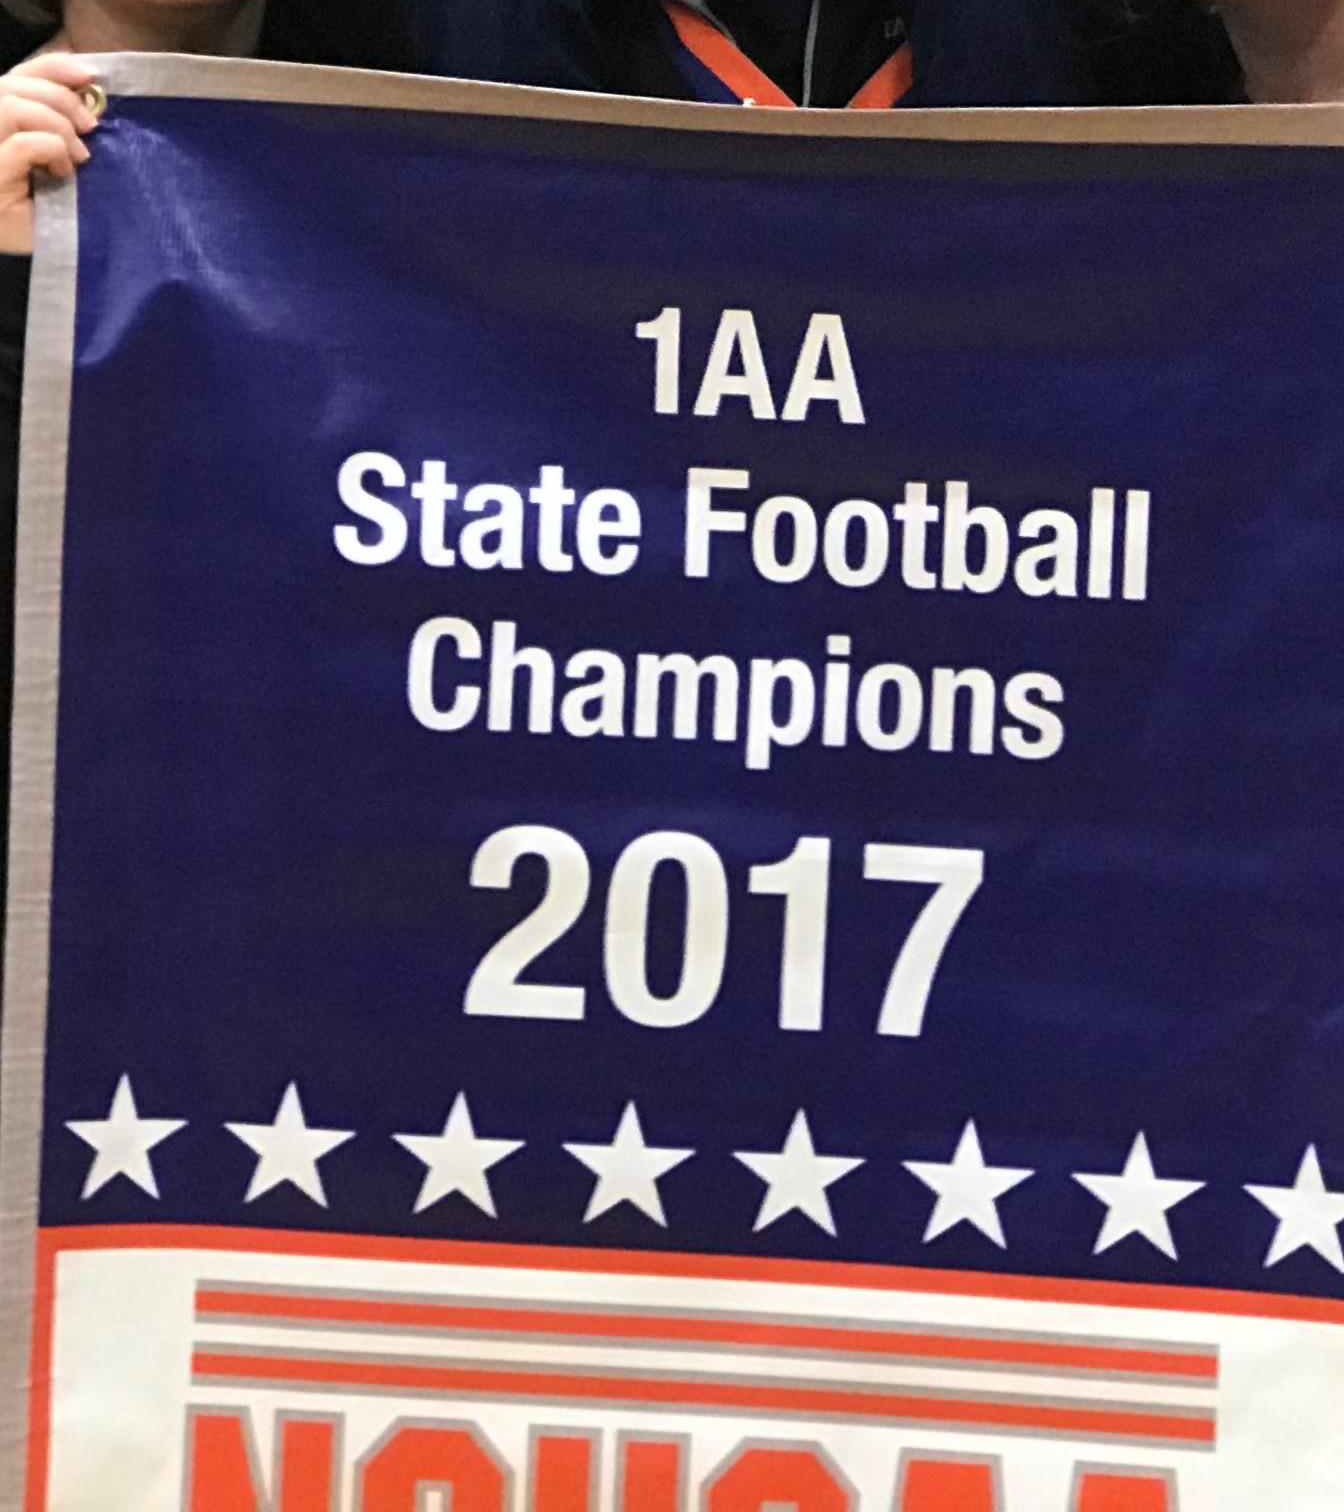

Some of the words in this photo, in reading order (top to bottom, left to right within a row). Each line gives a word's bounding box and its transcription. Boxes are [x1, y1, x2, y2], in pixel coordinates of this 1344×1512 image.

[636, 308, 865, 424] 1AA
[334, 452, 641, 575] State
[685, 468, 1150, 600] Football
[408, 617, 1063, 769] Champions
[464, 825, 984, 1037] 2017
